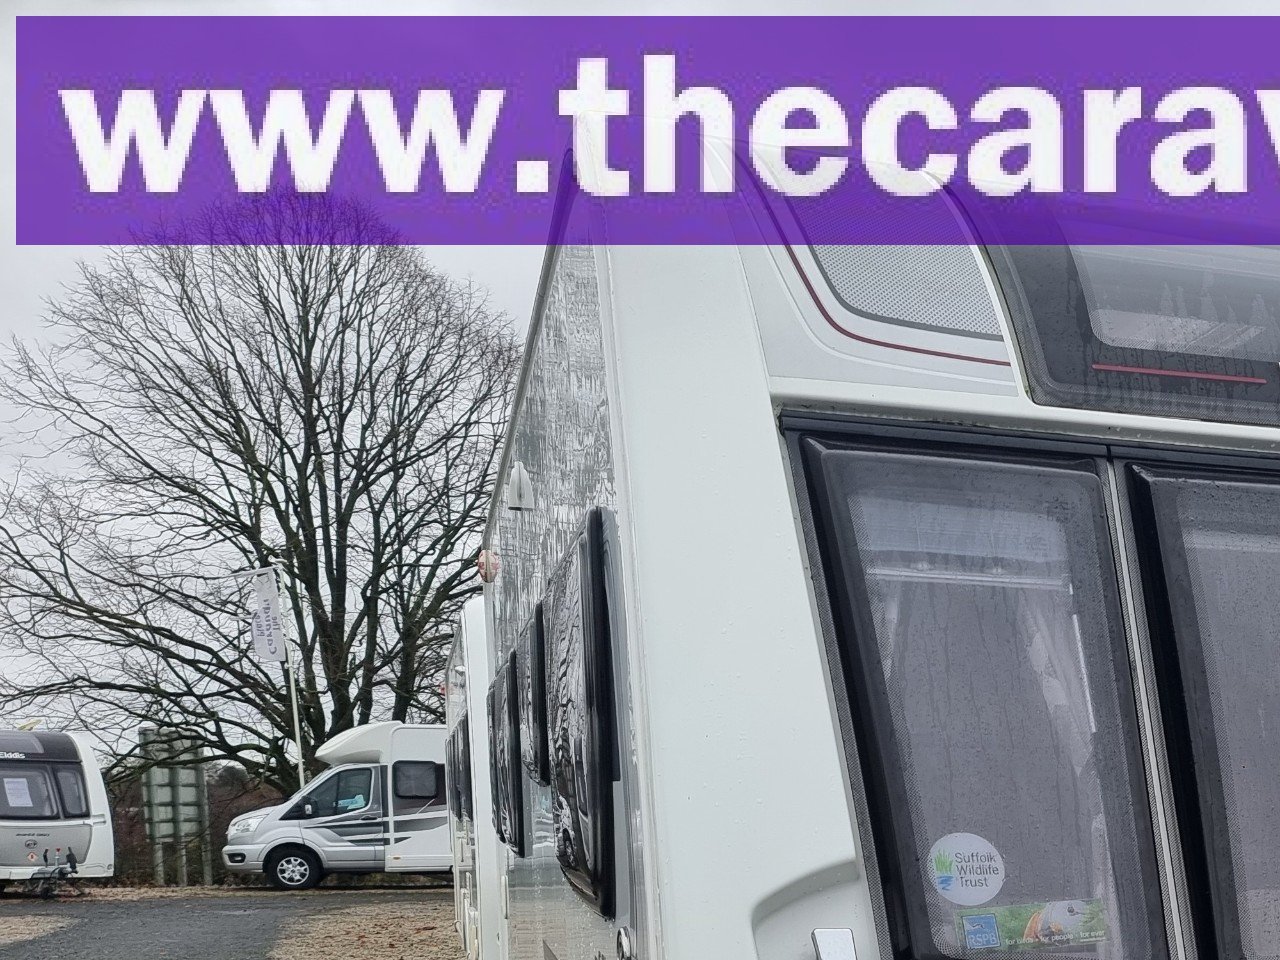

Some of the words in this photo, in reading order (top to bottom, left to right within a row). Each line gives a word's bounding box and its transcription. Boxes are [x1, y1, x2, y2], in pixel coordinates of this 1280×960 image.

[954, 852, 996, 864] Suffolk
[956, 864, 999, 876] Wildlife
[959, 876, 989, 888] Trust
[968, 931, 996, 945] RSPB
